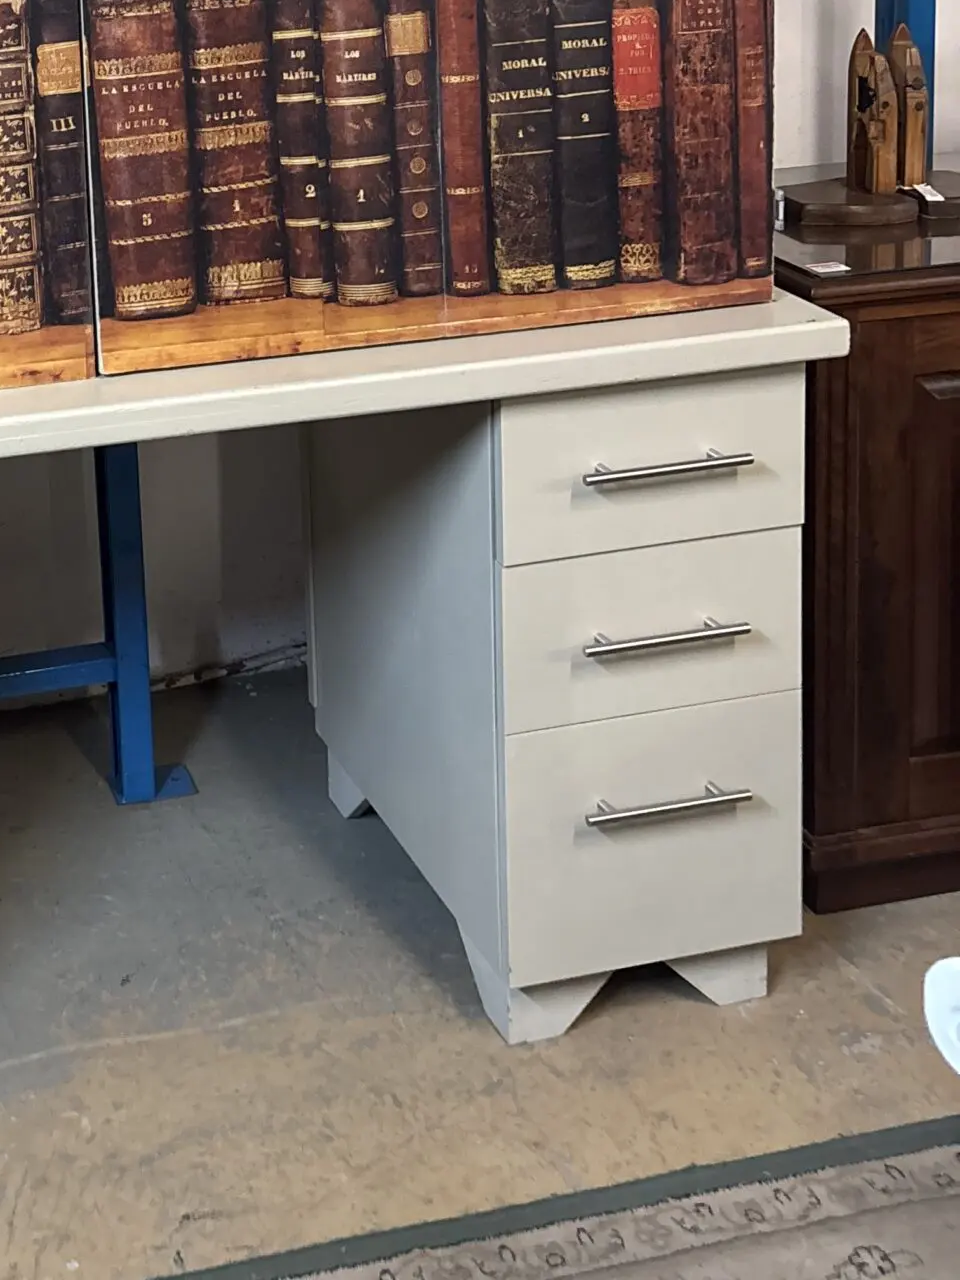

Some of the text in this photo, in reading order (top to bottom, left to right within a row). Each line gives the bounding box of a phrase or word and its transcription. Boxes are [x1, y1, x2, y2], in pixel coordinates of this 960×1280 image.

[561, 37, 608, 50] MORAL
[291, 49, 306, 60] LOS
[344, 50, 361, 59] LOS
[501, 57, 548, 71] MORAL
[192, 69, 268, 85] LA ESCUELA
[101, 80, 181, 95] LA ESCUELA
[218, 92, 243, 102] DEL
[488, 87, 553, 103] UNIVERSA
[129, 103, 154, 113] DEL
[50, 117, 77, 132] III
[518, 129, 525, 139] 1
[304, 183, 316, 198] 2
[356, 188, 367, 203] 1
